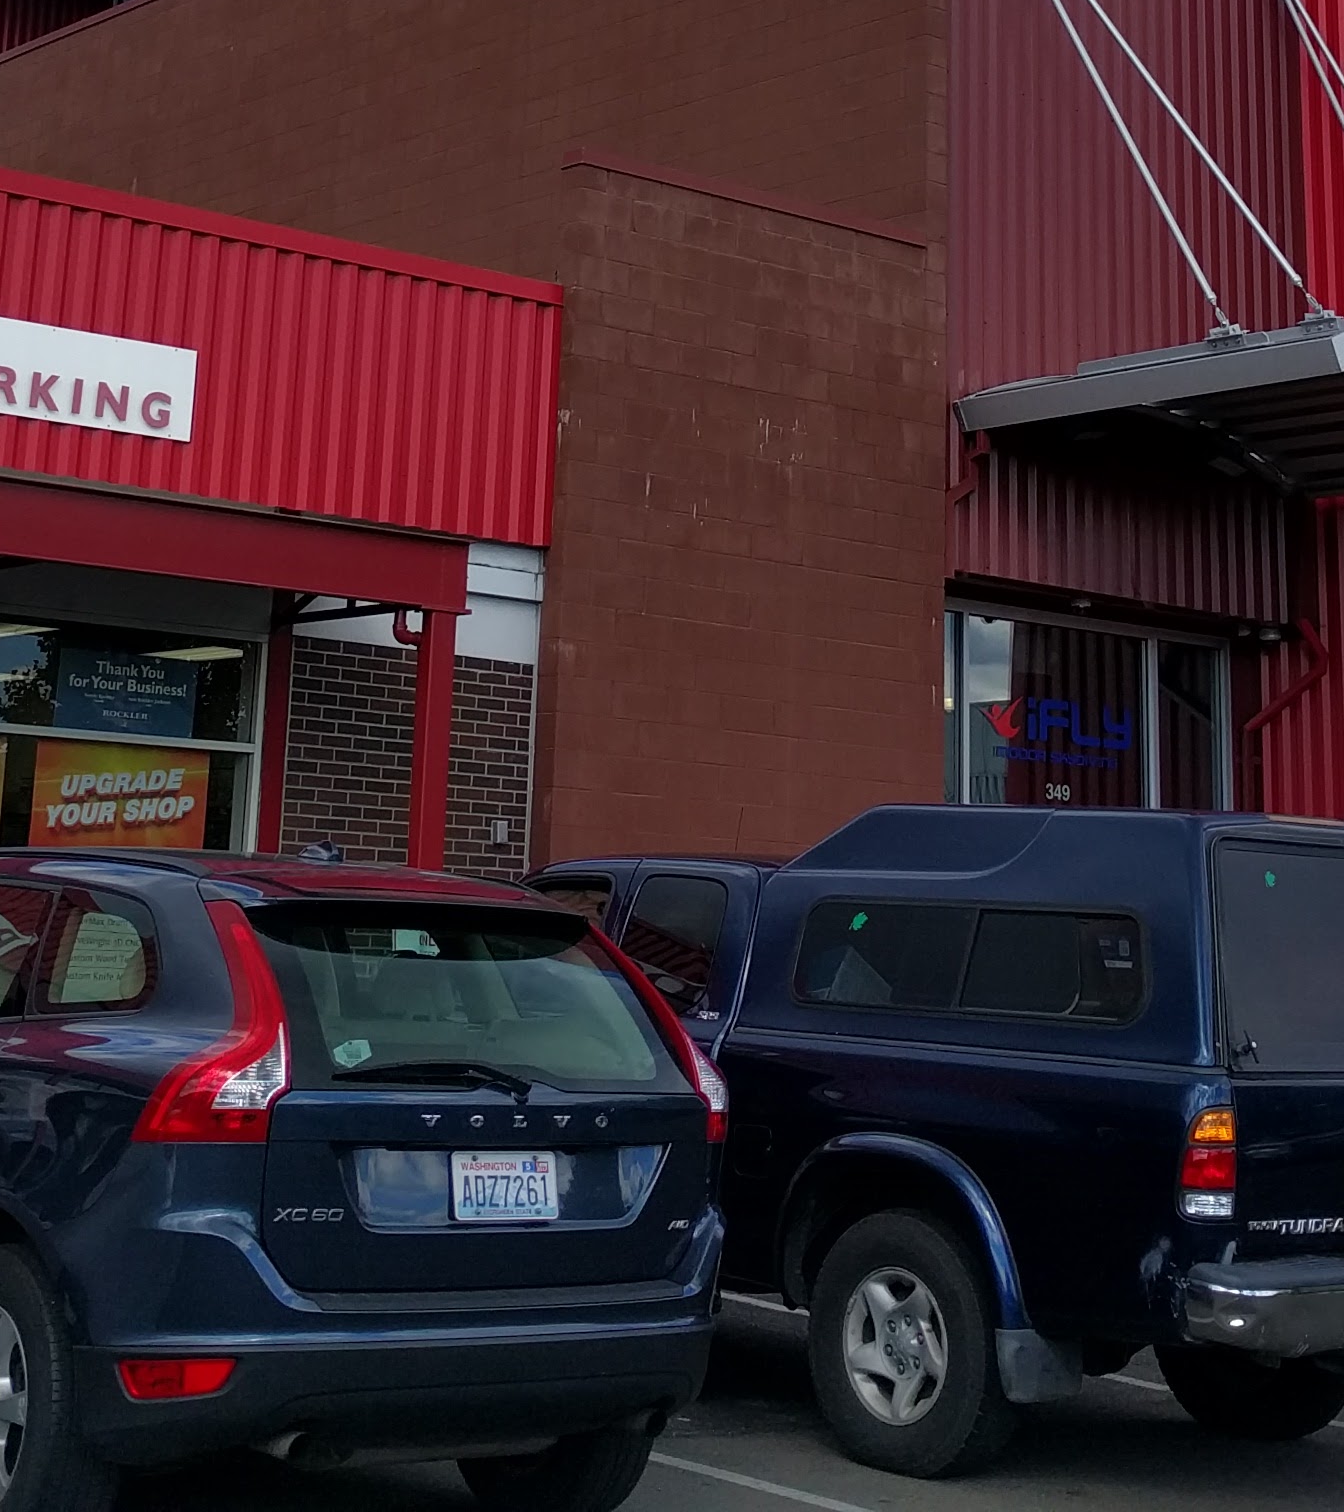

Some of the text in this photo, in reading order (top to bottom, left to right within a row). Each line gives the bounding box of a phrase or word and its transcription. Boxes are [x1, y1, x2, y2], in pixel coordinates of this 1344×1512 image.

[96, 660, 165, 679] Thank You
[69, 674, 187, 697] for Your Business!
[102, 710, 148, 720] ROCKLER
[60, 768, 186, 798] UPGRADE
[1045, 783, 1071, 802] 349
[46, 796, 195, 829] YOUR SHOP
[421, 1113, 608, 1128] VOLVO
[460, 1161, 517, 1171] WASHINGTON
[462, 1174, 548, 1208] ADZ7261
